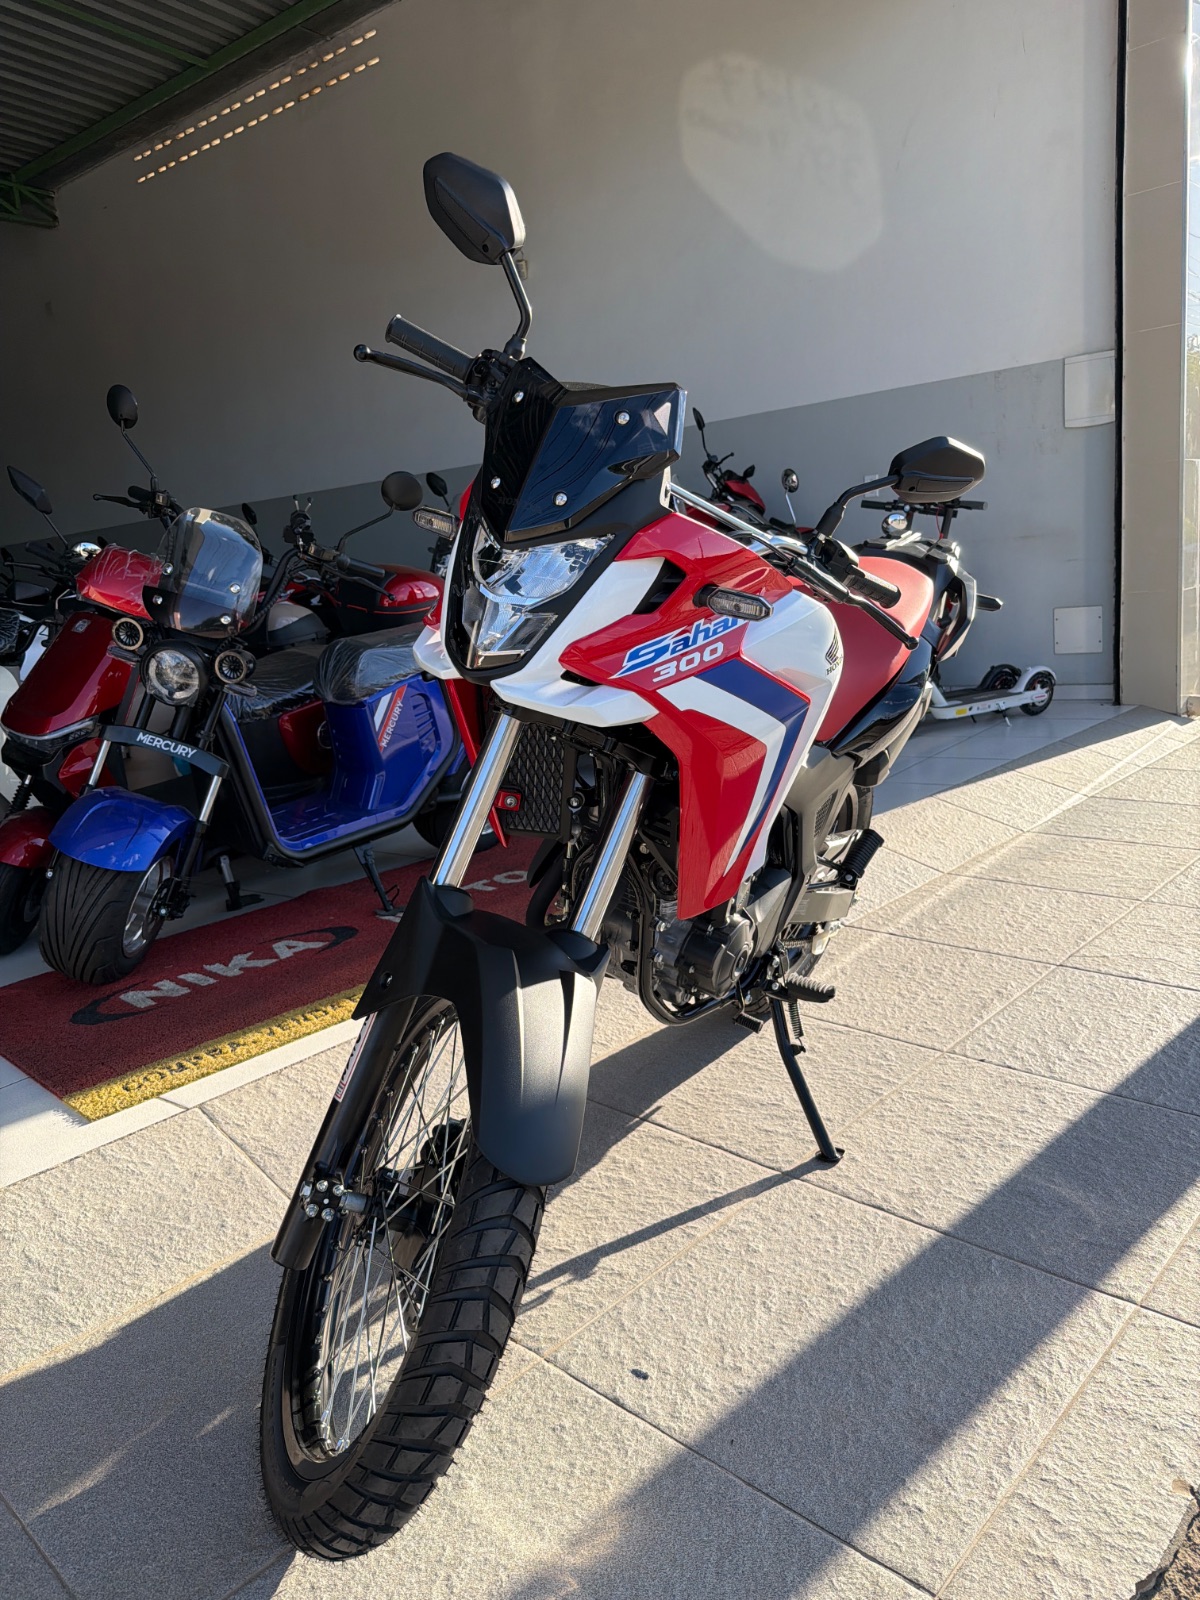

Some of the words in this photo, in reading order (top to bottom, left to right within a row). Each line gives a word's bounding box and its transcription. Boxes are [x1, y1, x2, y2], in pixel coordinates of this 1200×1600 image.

[609, 616, 746, 679] Sahar
[652, 641, 724, 683] 300
[136, 731, 197, 758] MERCURY
[380, 697, 404, 748] MERCURY
[119, 939, 329, 1009] NIKA
